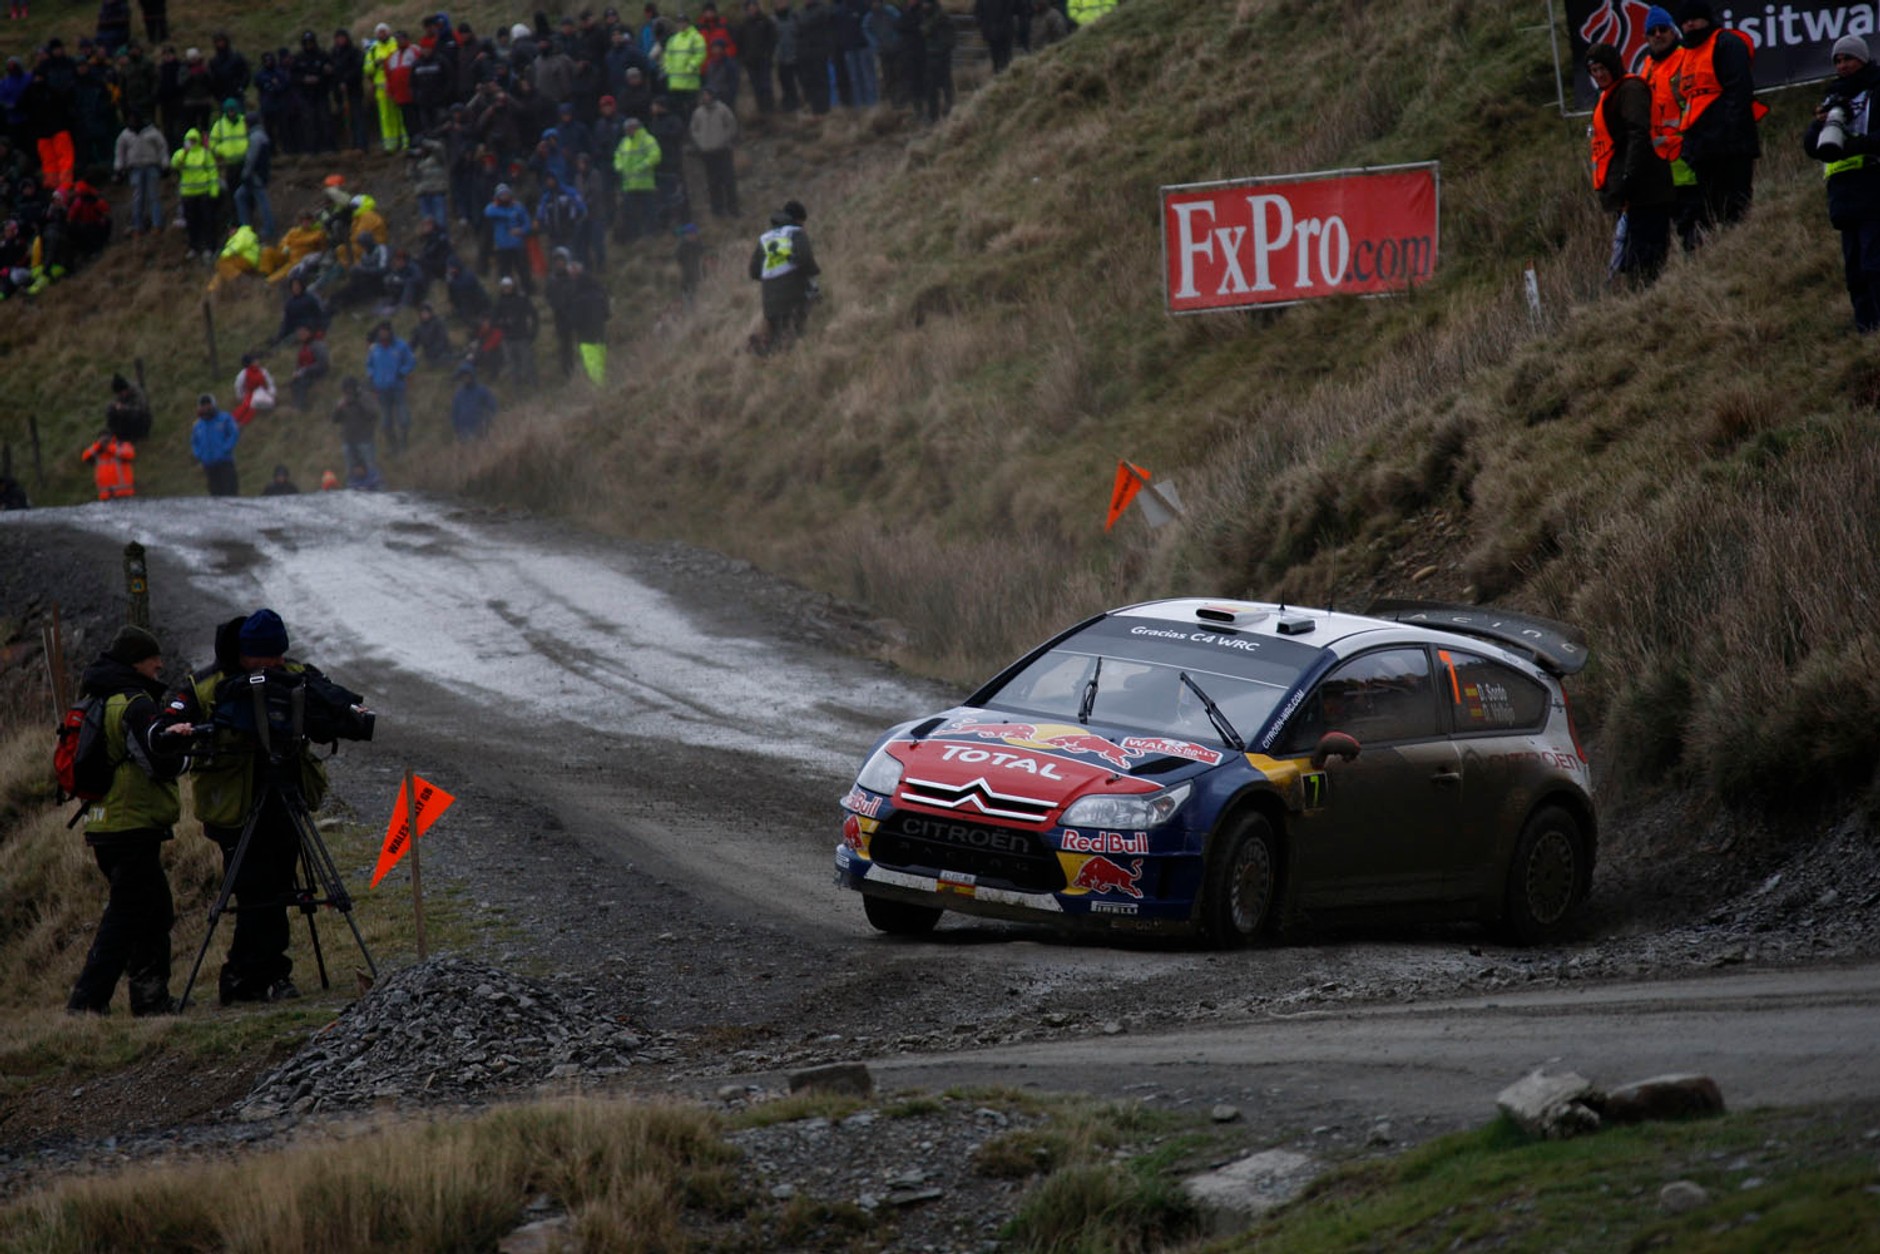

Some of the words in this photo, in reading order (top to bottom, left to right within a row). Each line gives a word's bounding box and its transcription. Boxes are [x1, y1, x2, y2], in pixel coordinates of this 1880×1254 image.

[1171, 194, 1432, 299] FxPro.com
[1130, 625, 1186, 641] Gracias
[1190, 633, 1212, 644] C4
[1218, 637, 1260, 651] WRC
[942, 745, 1062, 781] TOTAL
[1309, 775, 1320, 807] 7
[387, 822, 409, 854] WALES
[1090, 900, 1139, 915] PIRELLI
